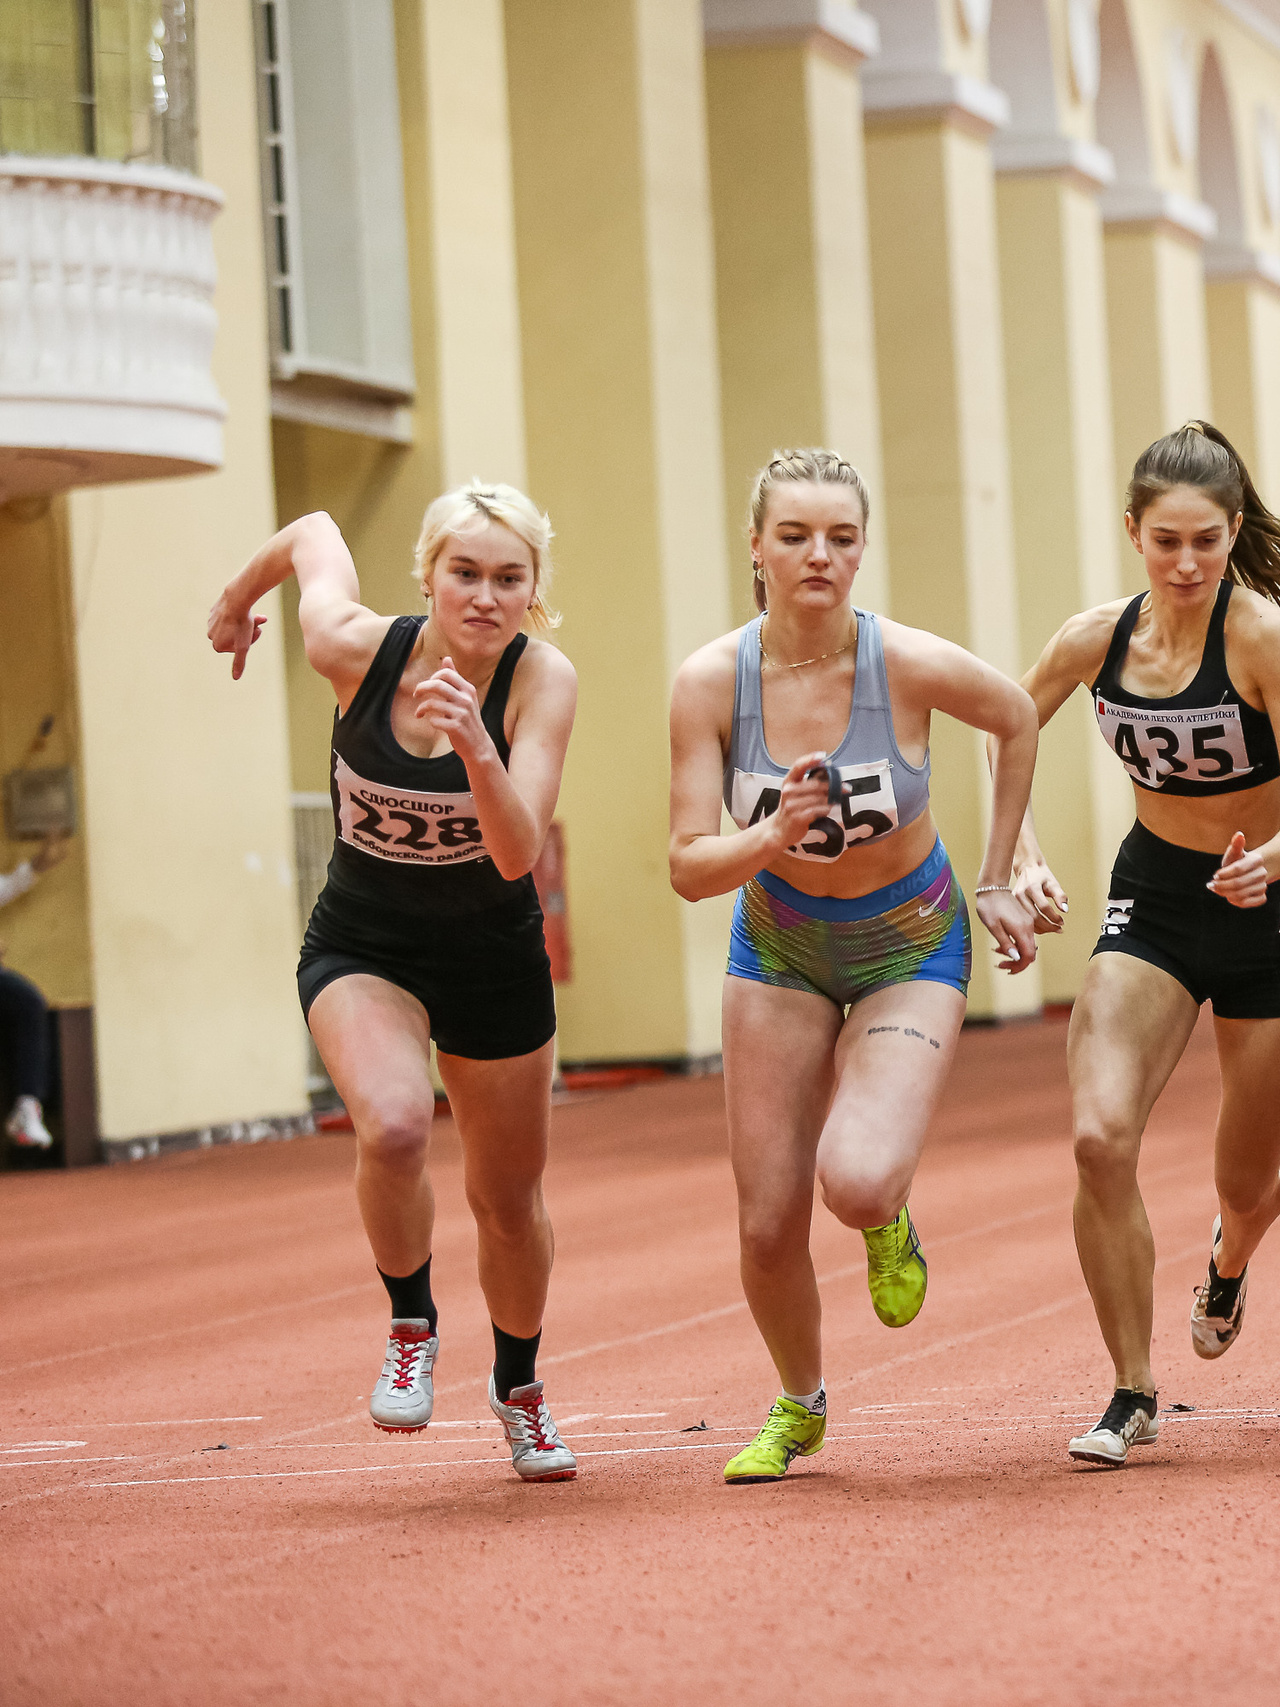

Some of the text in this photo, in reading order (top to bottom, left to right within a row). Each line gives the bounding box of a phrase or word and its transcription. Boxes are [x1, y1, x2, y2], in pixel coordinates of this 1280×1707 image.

[1106, 707, 1236, 723] АКАДЕМИЯ ЛЕГКОЙ АТЛЕТИКИ
[1114, 723, 1234, 782] 435
[360, 790, 455, 815] СДЮСШОР
[349, 791, 482, 851] 228
[352, 831, 487, 862] Выборгского район
